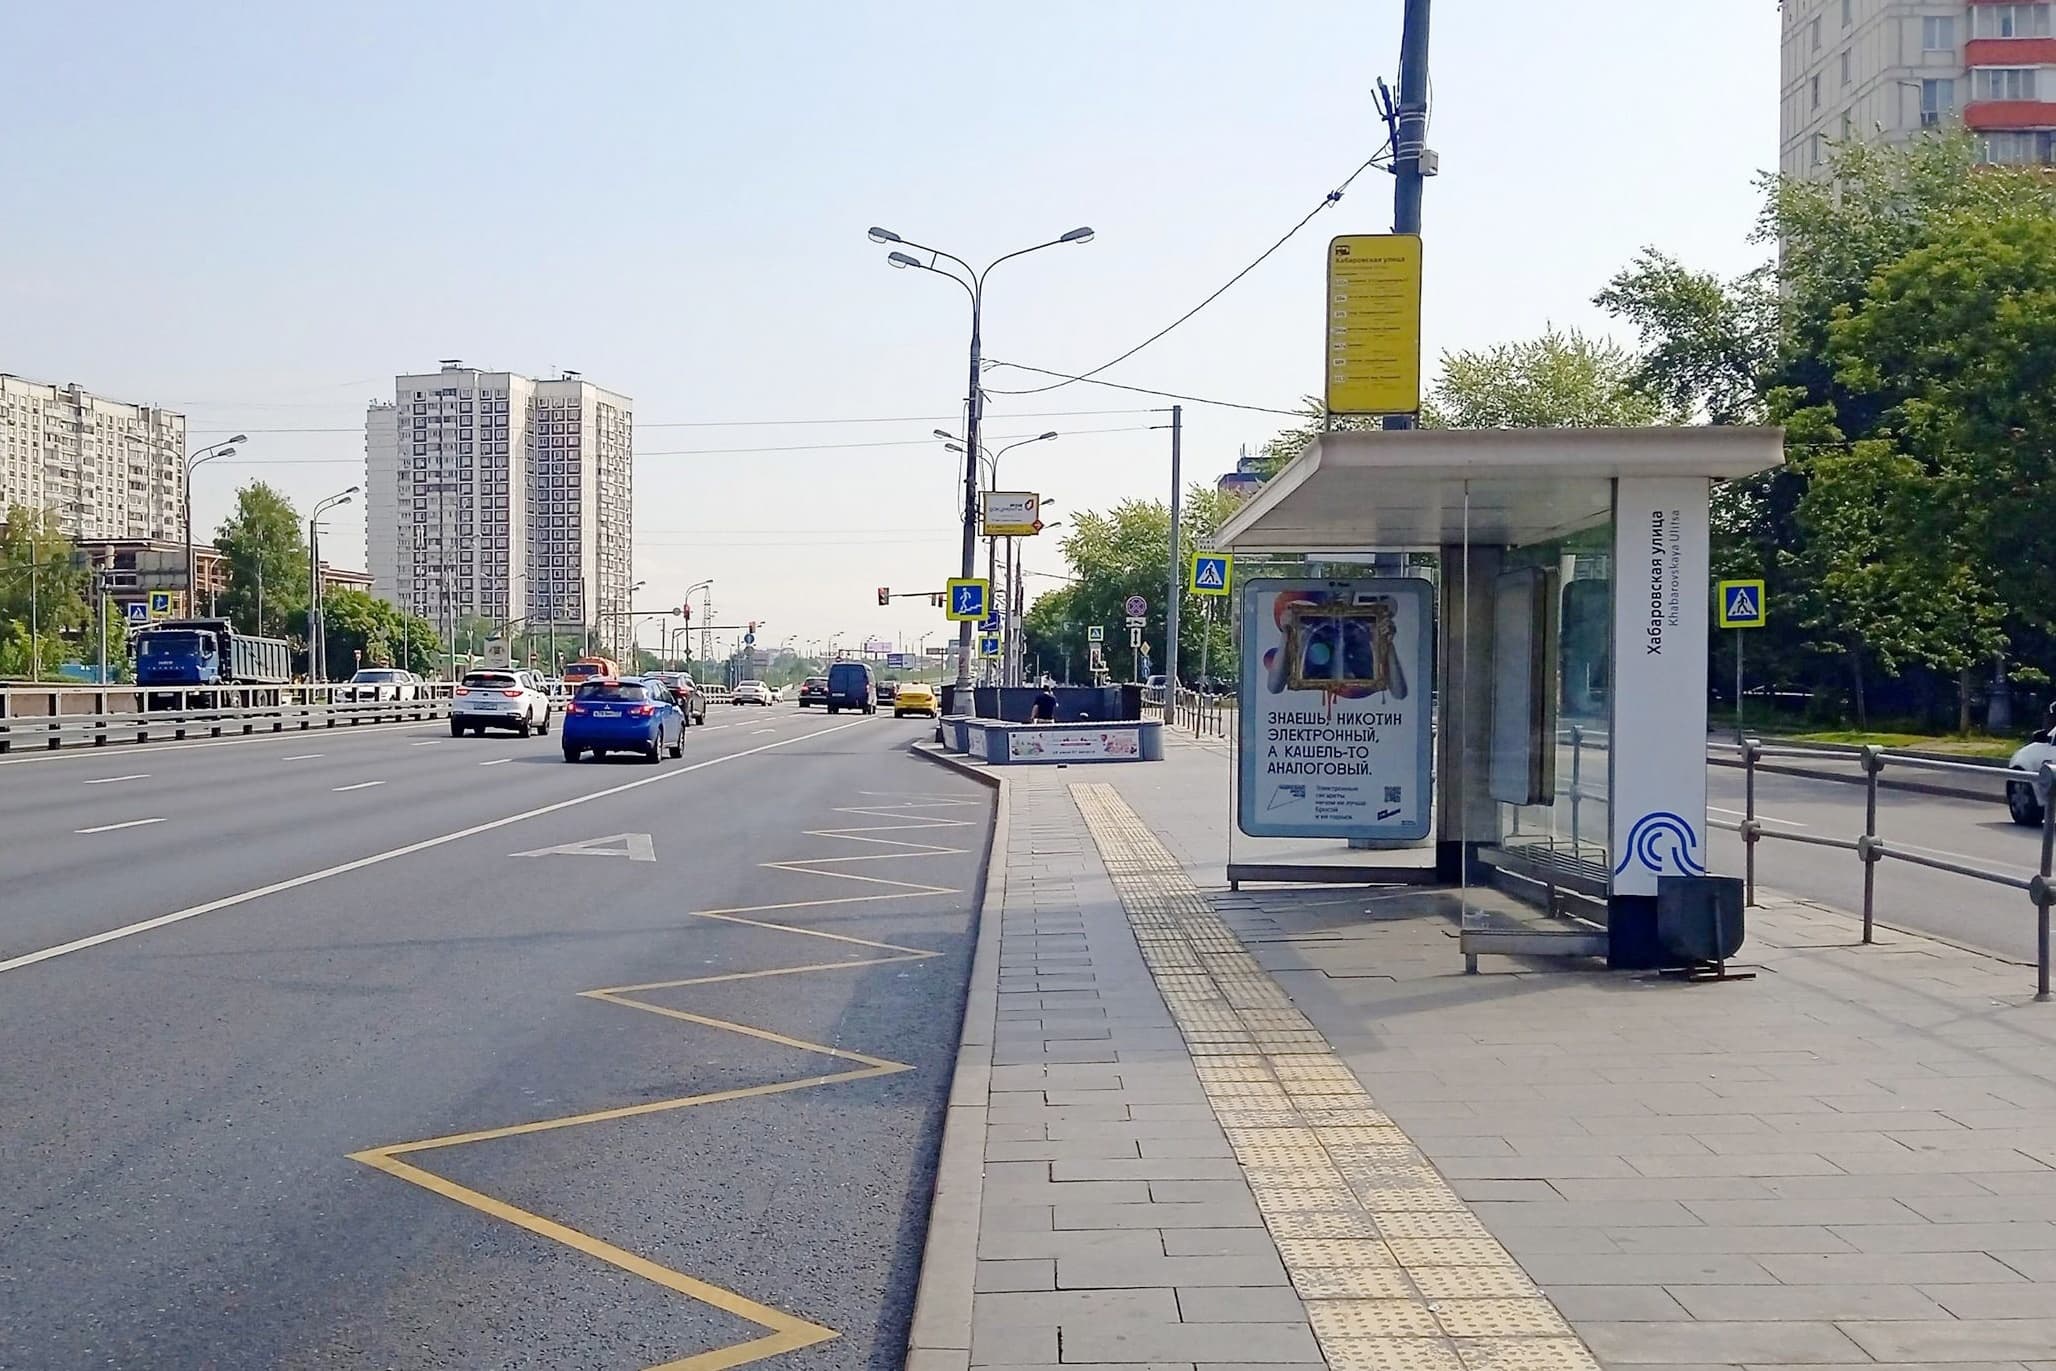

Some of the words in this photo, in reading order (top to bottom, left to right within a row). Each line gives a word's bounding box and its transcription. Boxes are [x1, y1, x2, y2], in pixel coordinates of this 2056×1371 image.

[1335, 256, 1382, 264] Хабаровская
[1384, 256, 1405, 264] улица
[1652, 510, 1666, 555] улица
[1669, 510, 1681, 542] Ulitsa
[1668, 545, 1682, 627] Khabarovskaya
[1647, 558, 1665, 655] Хабаровская
[1268, 711, 1330, 726] ЗНАЕШЬ,
[1337, 712, 1402, 725] НИКОТИН
[1268, 727, 1380, 743] ЭЛЕКТРОННЫЙ,
[1267, 746, 1278, 758] А
[1285, 746, 1369, 758] КАШЕЛЬ-ТО
[1267, 761, 1372, 775] АНАЛОГОВЫЙ.
[507, 833, 656, 862] А
